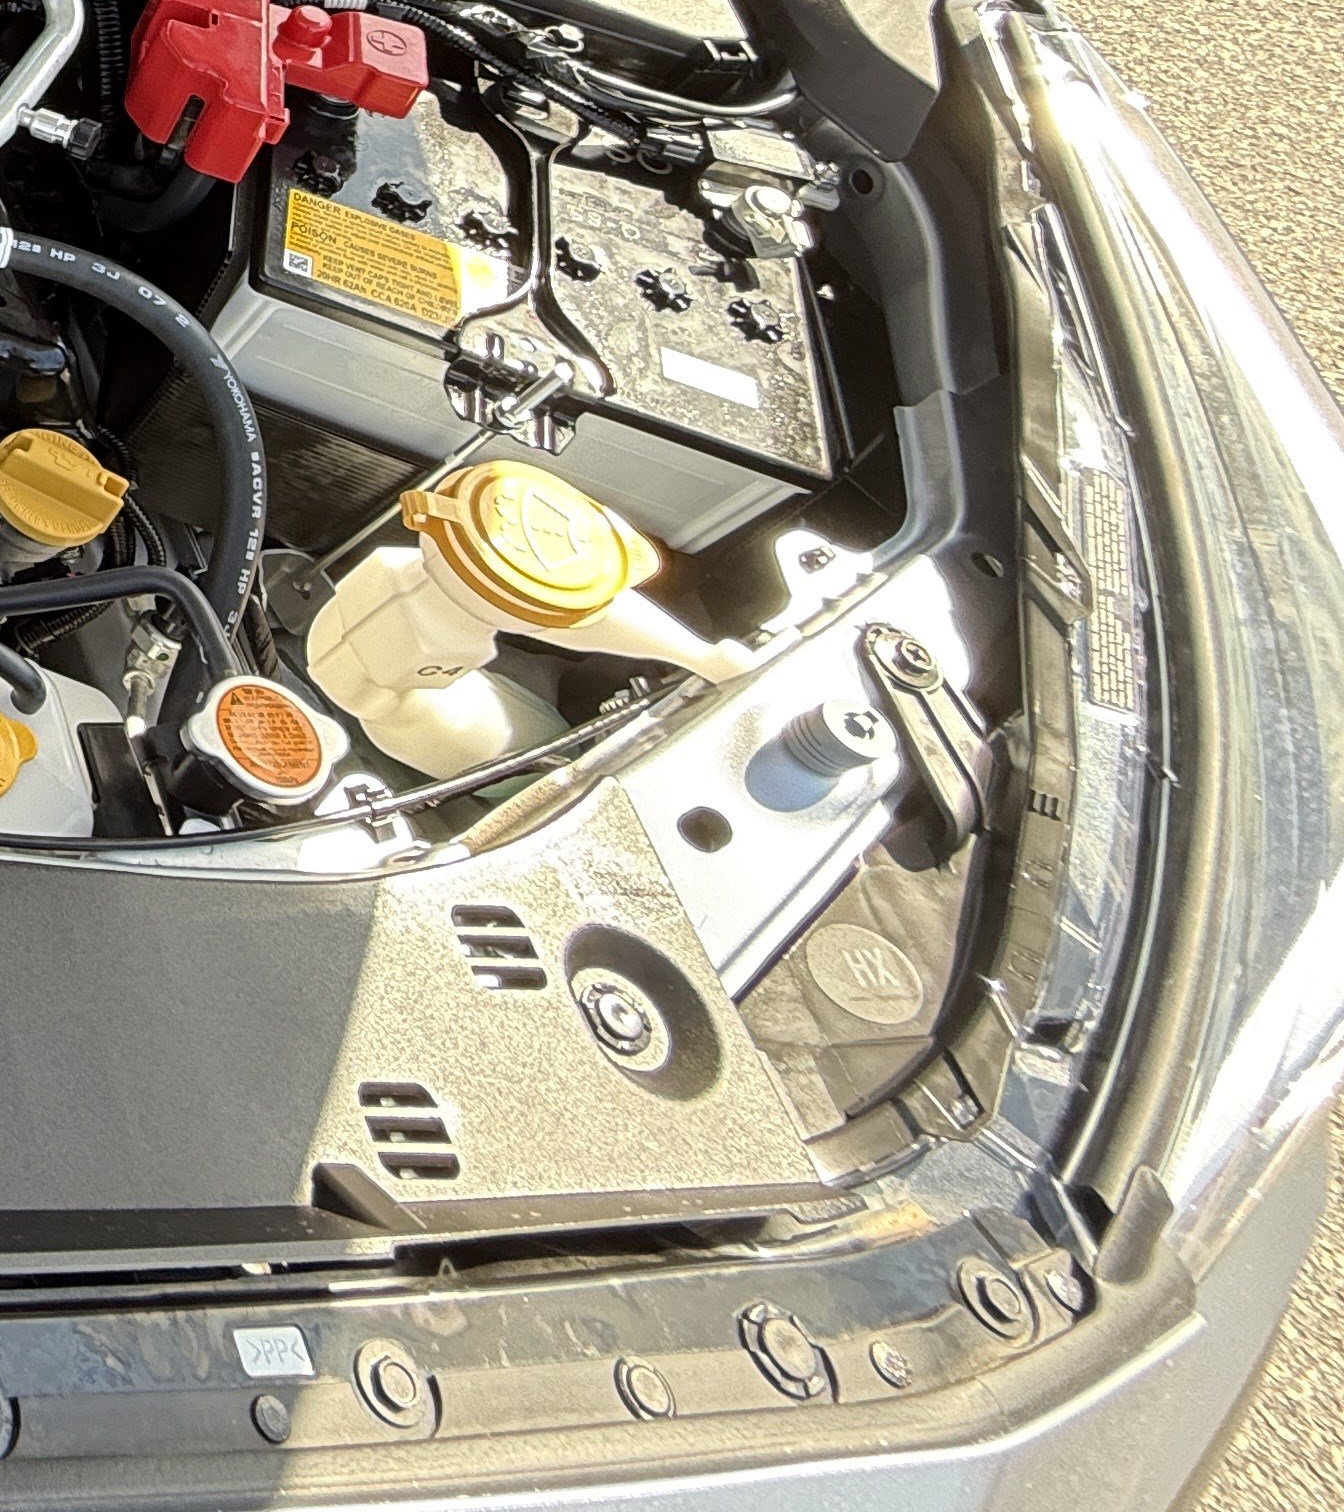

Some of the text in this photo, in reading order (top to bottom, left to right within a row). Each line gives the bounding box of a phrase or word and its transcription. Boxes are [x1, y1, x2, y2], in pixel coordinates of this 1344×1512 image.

[293, 191, 341, 215] DANGER
[344, 210, 386, 230] EXPLOSIVE
[290, 220, 336, 244] POISON
[343, 240, 374, 257] CAUSES
[49, 247, 76, 262] HP
[91, 261, 121, 281] 3J
[137, 285, 167, 306] 07
[174, 313, 191, 329] 2
[370, 288, 391, 302] CCA
[223, 370, 258, 443] YOKOHAMA
[237, 568, 251, 595] HP
[416, 665, 464, 677] C4
[840, 947, 902, 989] HX
